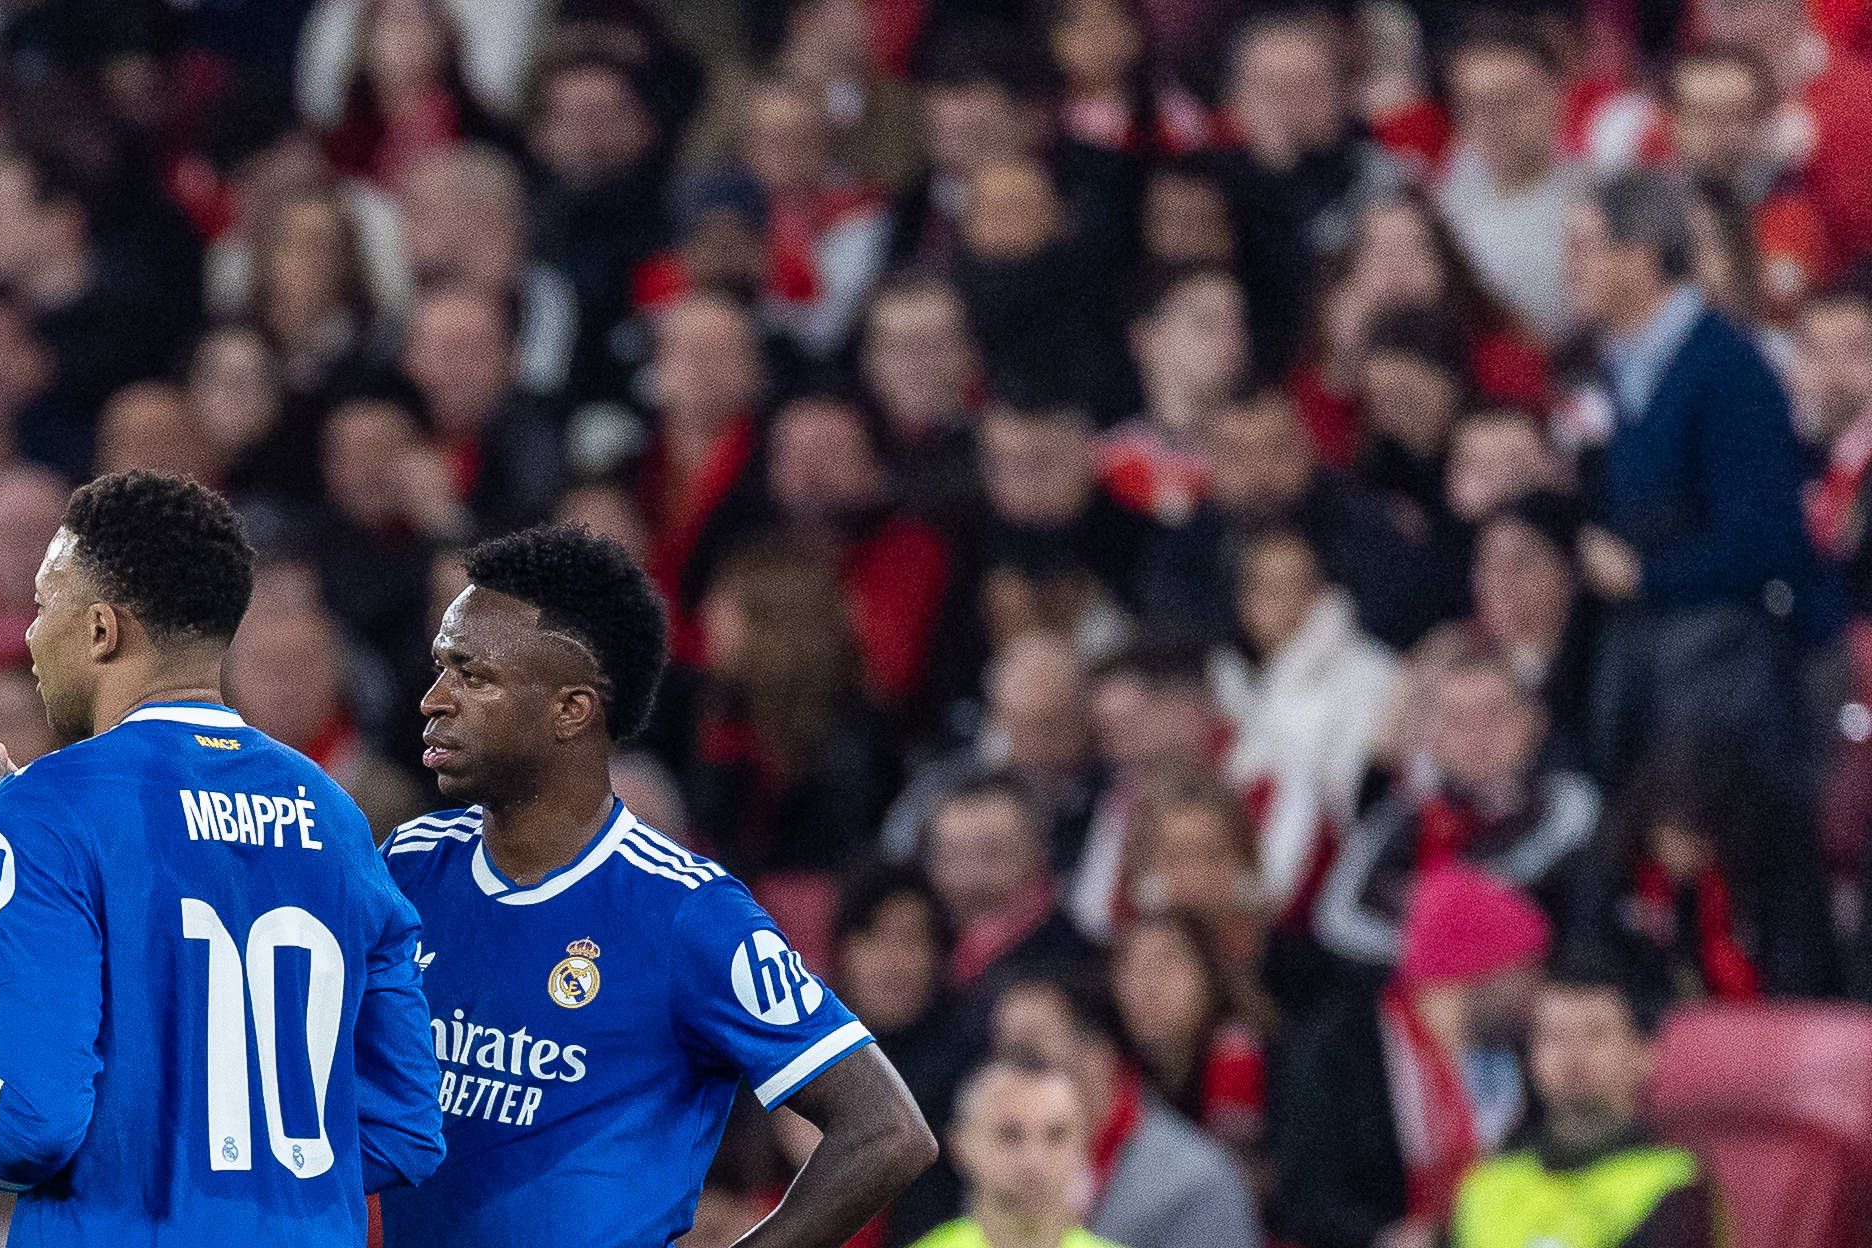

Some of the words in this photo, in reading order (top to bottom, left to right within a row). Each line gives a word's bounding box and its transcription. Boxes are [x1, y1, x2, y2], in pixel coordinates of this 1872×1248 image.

[193, 734, 241, 750] RMCF
[179, 785, 323, 850] MBAPPÉ
[736, 929, 818, 1024] hp
[181, 898, 345, 1179] 10
[438, 1070, 543, 1126] BETTER
